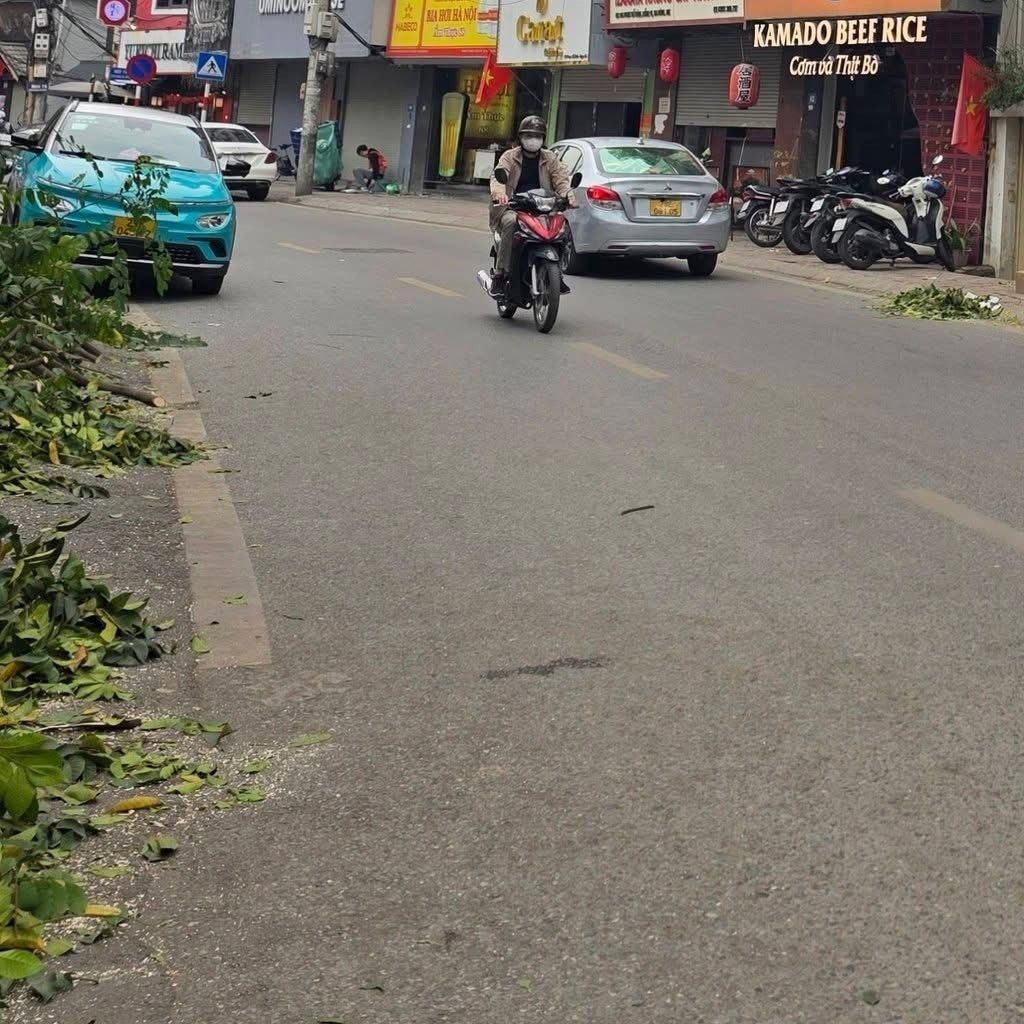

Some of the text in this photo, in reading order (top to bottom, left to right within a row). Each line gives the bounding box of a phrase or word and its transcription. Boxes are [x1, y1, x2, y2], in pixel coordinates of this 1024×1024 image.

[753, 15, 928, 47] KAMADO BEEF RICE
[790, 54, 879, 80] Cơm và Thịt Bò
